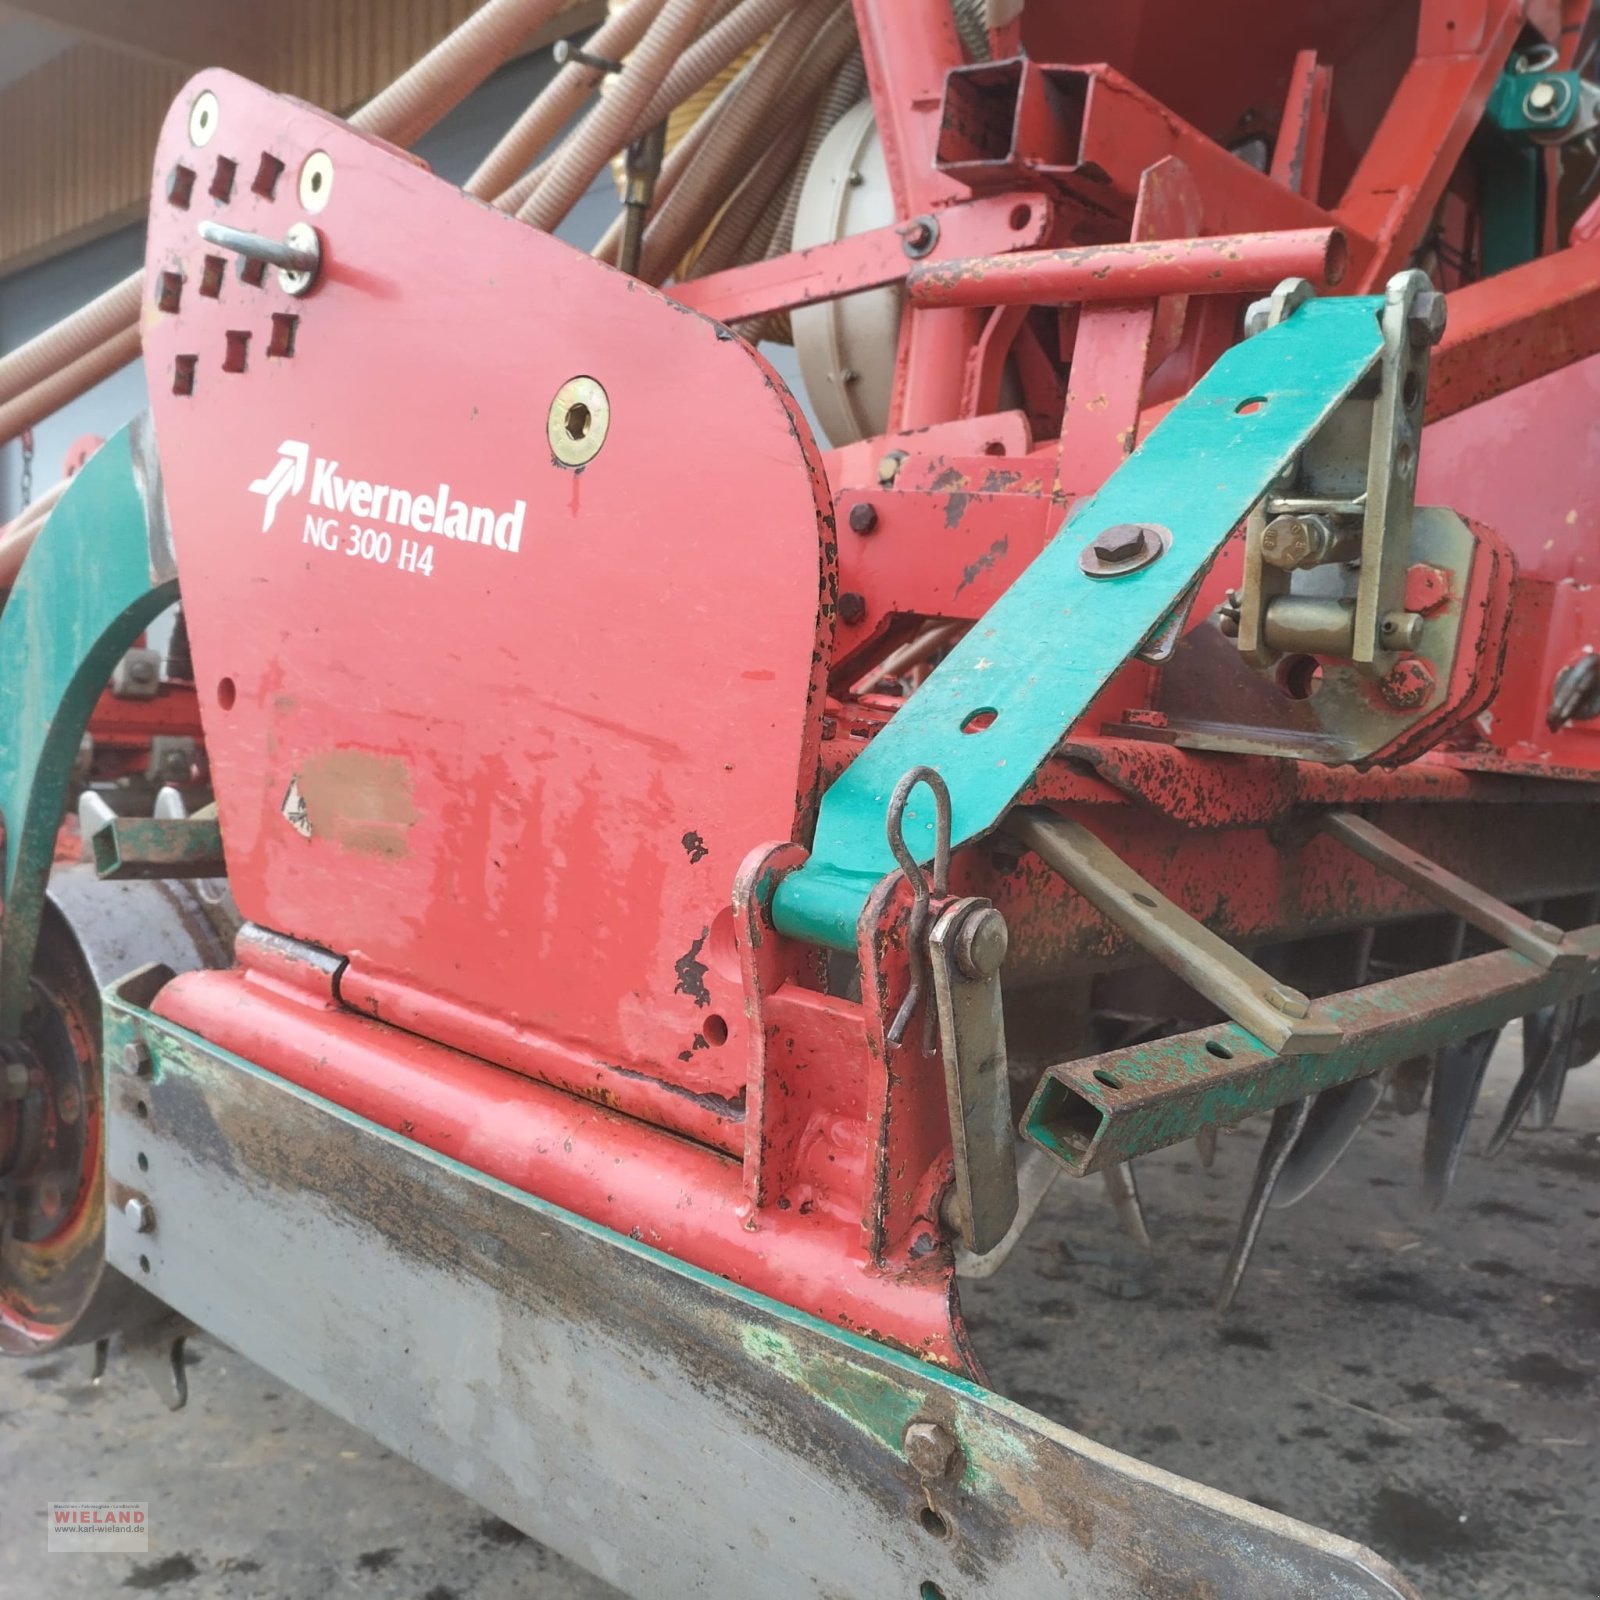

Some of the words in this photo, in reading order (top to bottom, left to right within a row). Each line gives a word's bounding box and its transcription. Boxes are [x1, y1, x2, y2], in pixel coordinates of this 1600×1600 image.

[309, 457, 527, 553] Kverneland
[302, 514, 339, 551] NG
[345, 524, 392, 563] 300
[397, 538, 435, 576] H4
